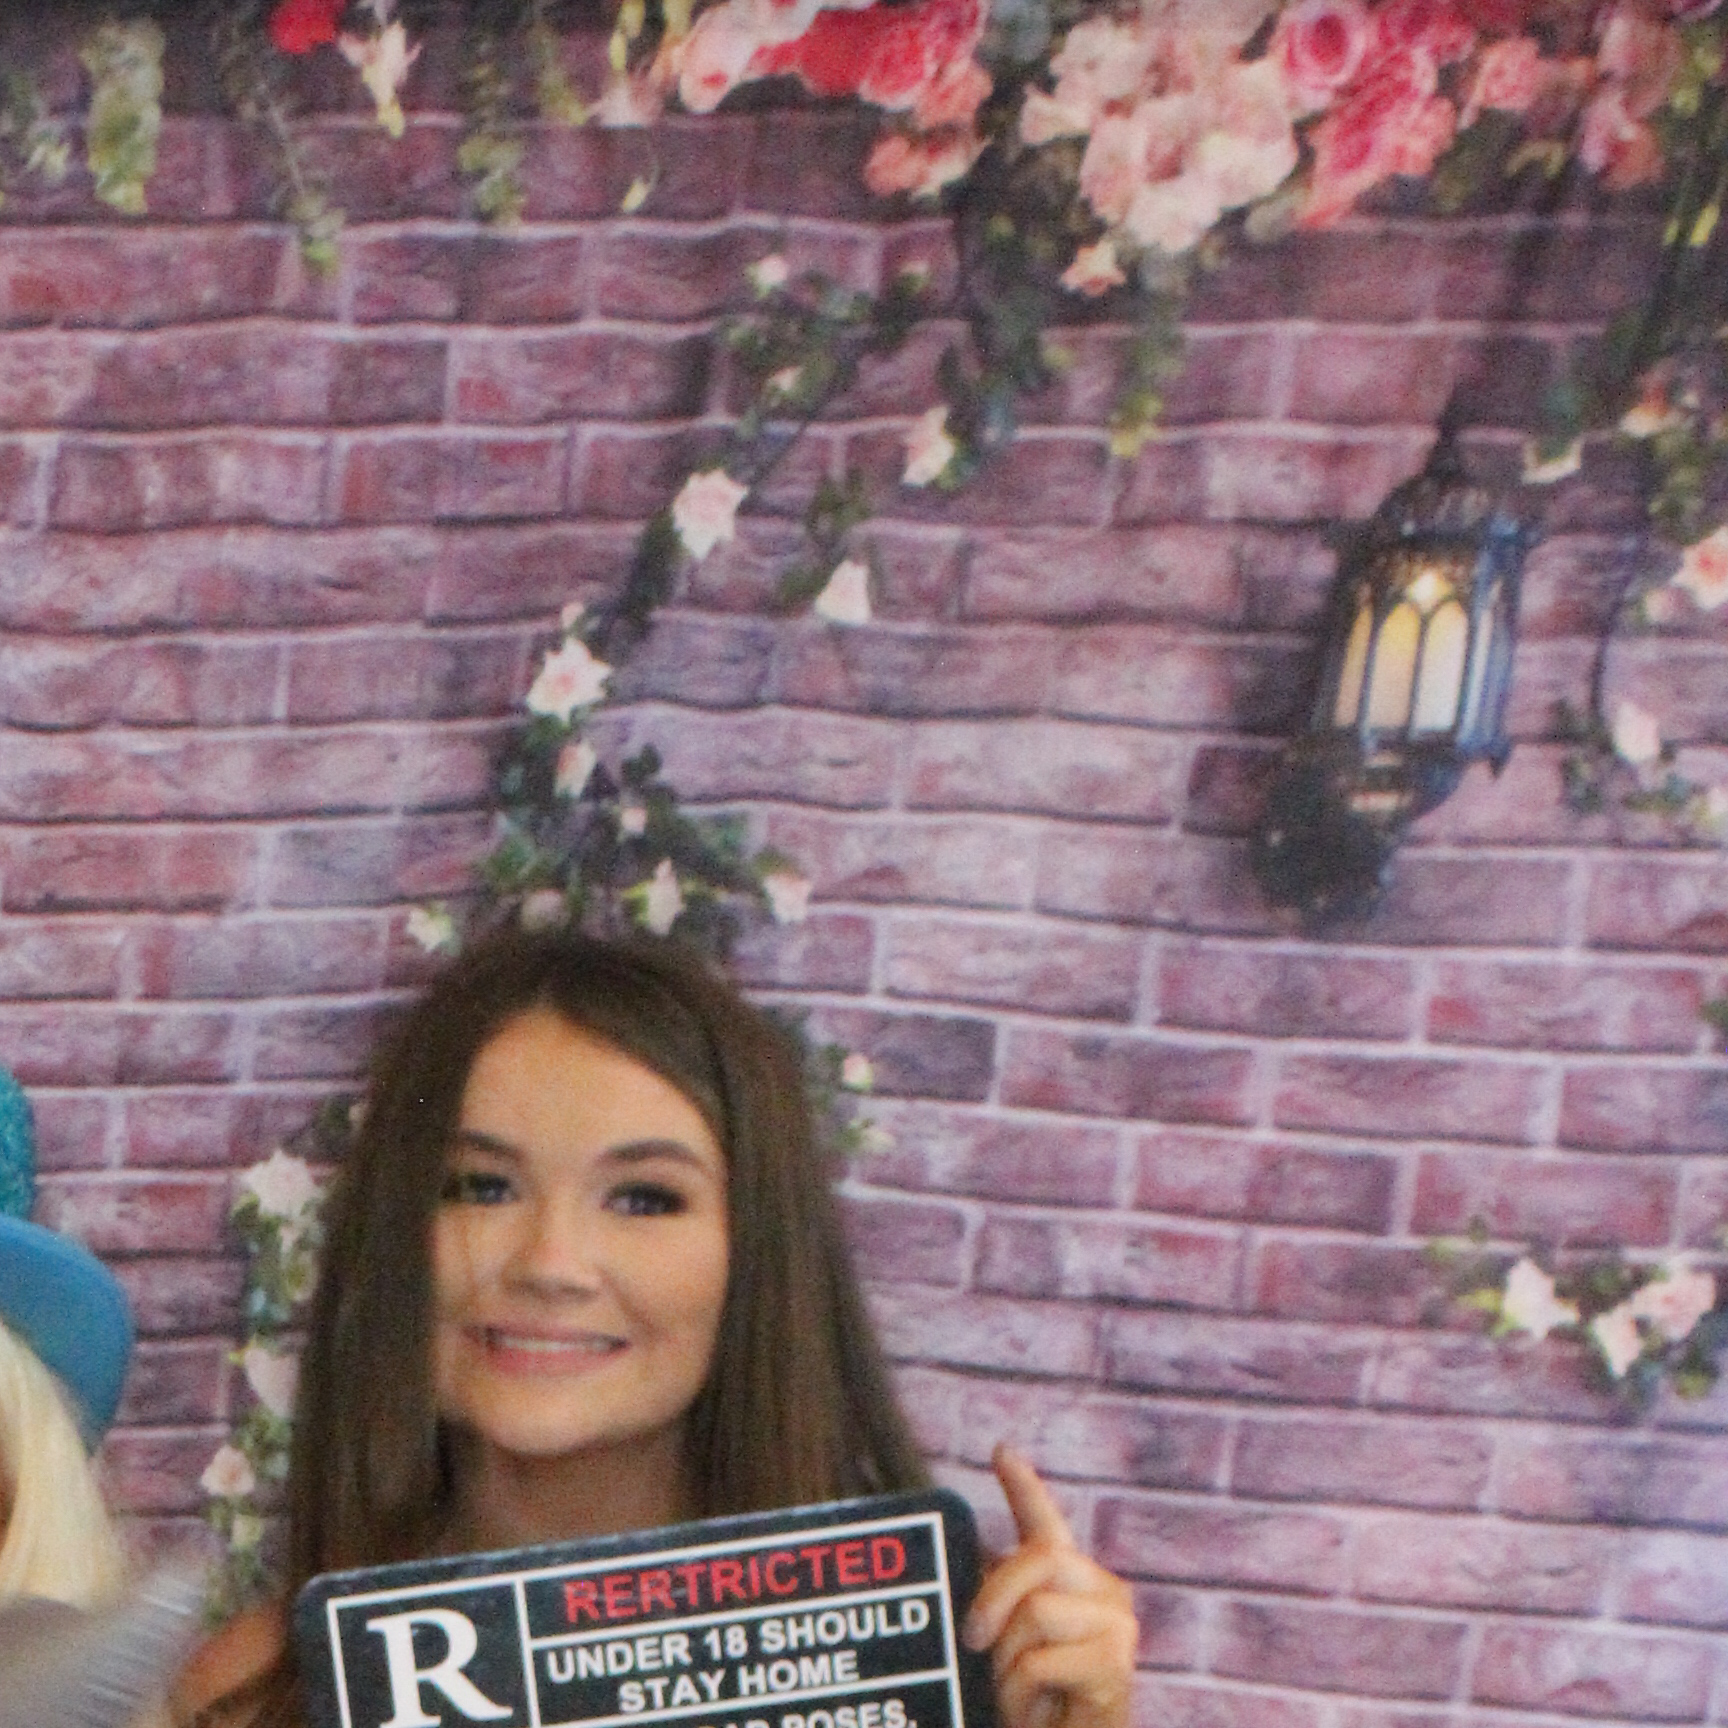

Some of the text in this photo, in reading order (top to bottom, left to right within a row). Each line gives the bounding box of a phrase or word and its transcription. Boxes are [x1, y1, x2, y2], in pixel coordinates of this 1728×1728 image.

[563, 1535, 907, 1624] RERTRICTED
[547, 1599, 931, 1684] UNDER 18 SHOULD
[618, 1650, 860, 1714] STAY HOME
